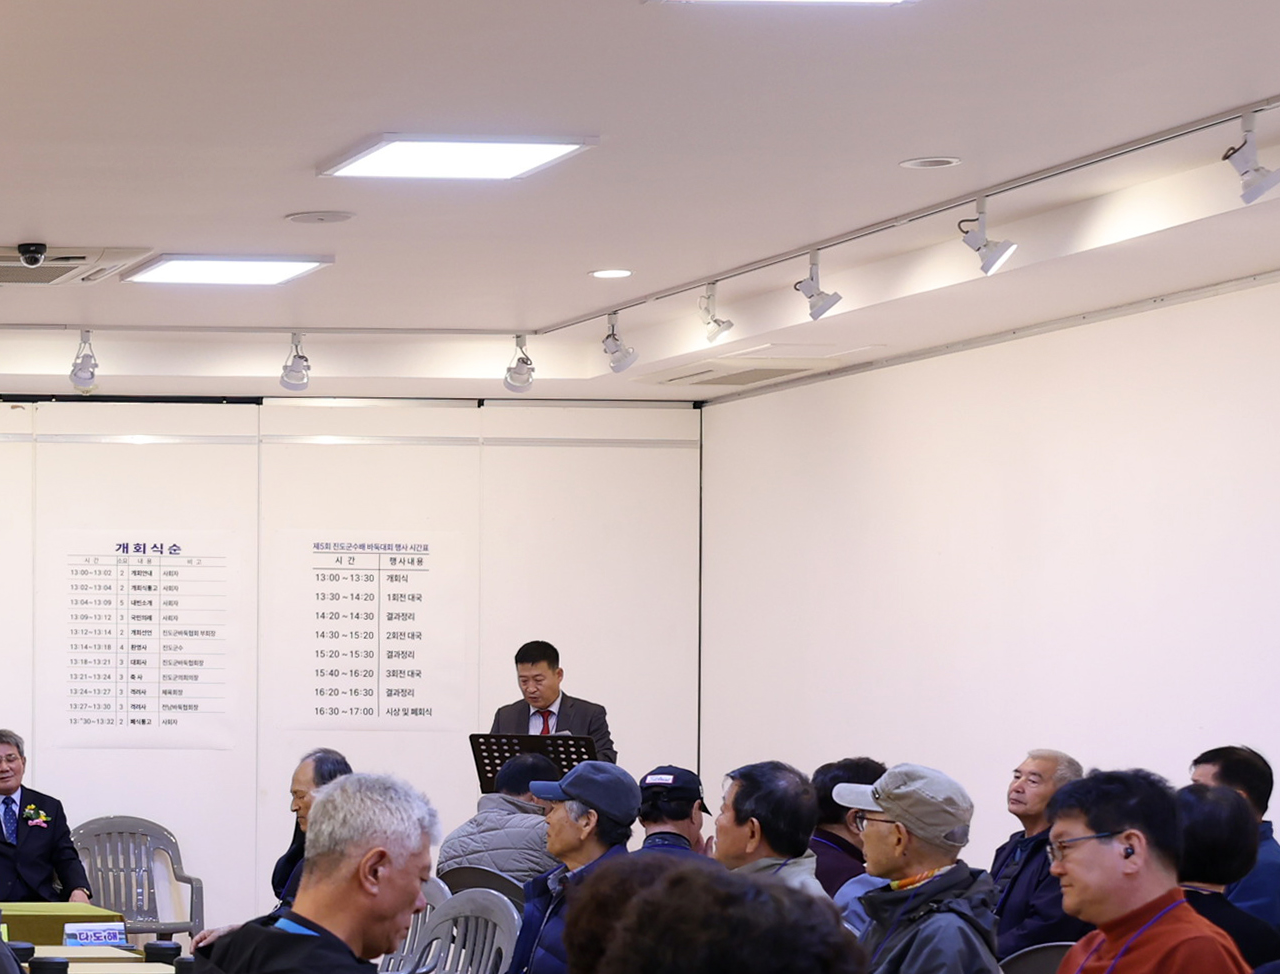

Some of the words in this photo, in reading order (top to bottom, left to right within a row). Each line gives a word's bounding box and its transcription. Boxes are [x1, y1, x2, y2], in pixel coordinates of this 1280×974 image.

[313, 542, 331, 550] 제5회
[333, 543, 366, 551] 진도군수배
[367, 543, 394, 551] 바둑대회
[395, 544, 408, 552] 행사
[409, 544, 429, 552] 시간표
[386, 574, 408, 583] 개회식
[387, 593, 406, 602] 1회전
[408, 593, 422, 602] 대국
[386, 612, 415, 622] 결과정리
[386, 631, 406, 641] 2회전
[407, 631, 422, 640] 대국
[386, 650, 415, 660] 결과정리
[386, 669, 406, 679] 3회전
[407, 670, 422, 678] 대국
[386, 688, 415, 698] 결과정리
[386, 708, 401, 717] 시상
[402, 708, 409, 716] 및
